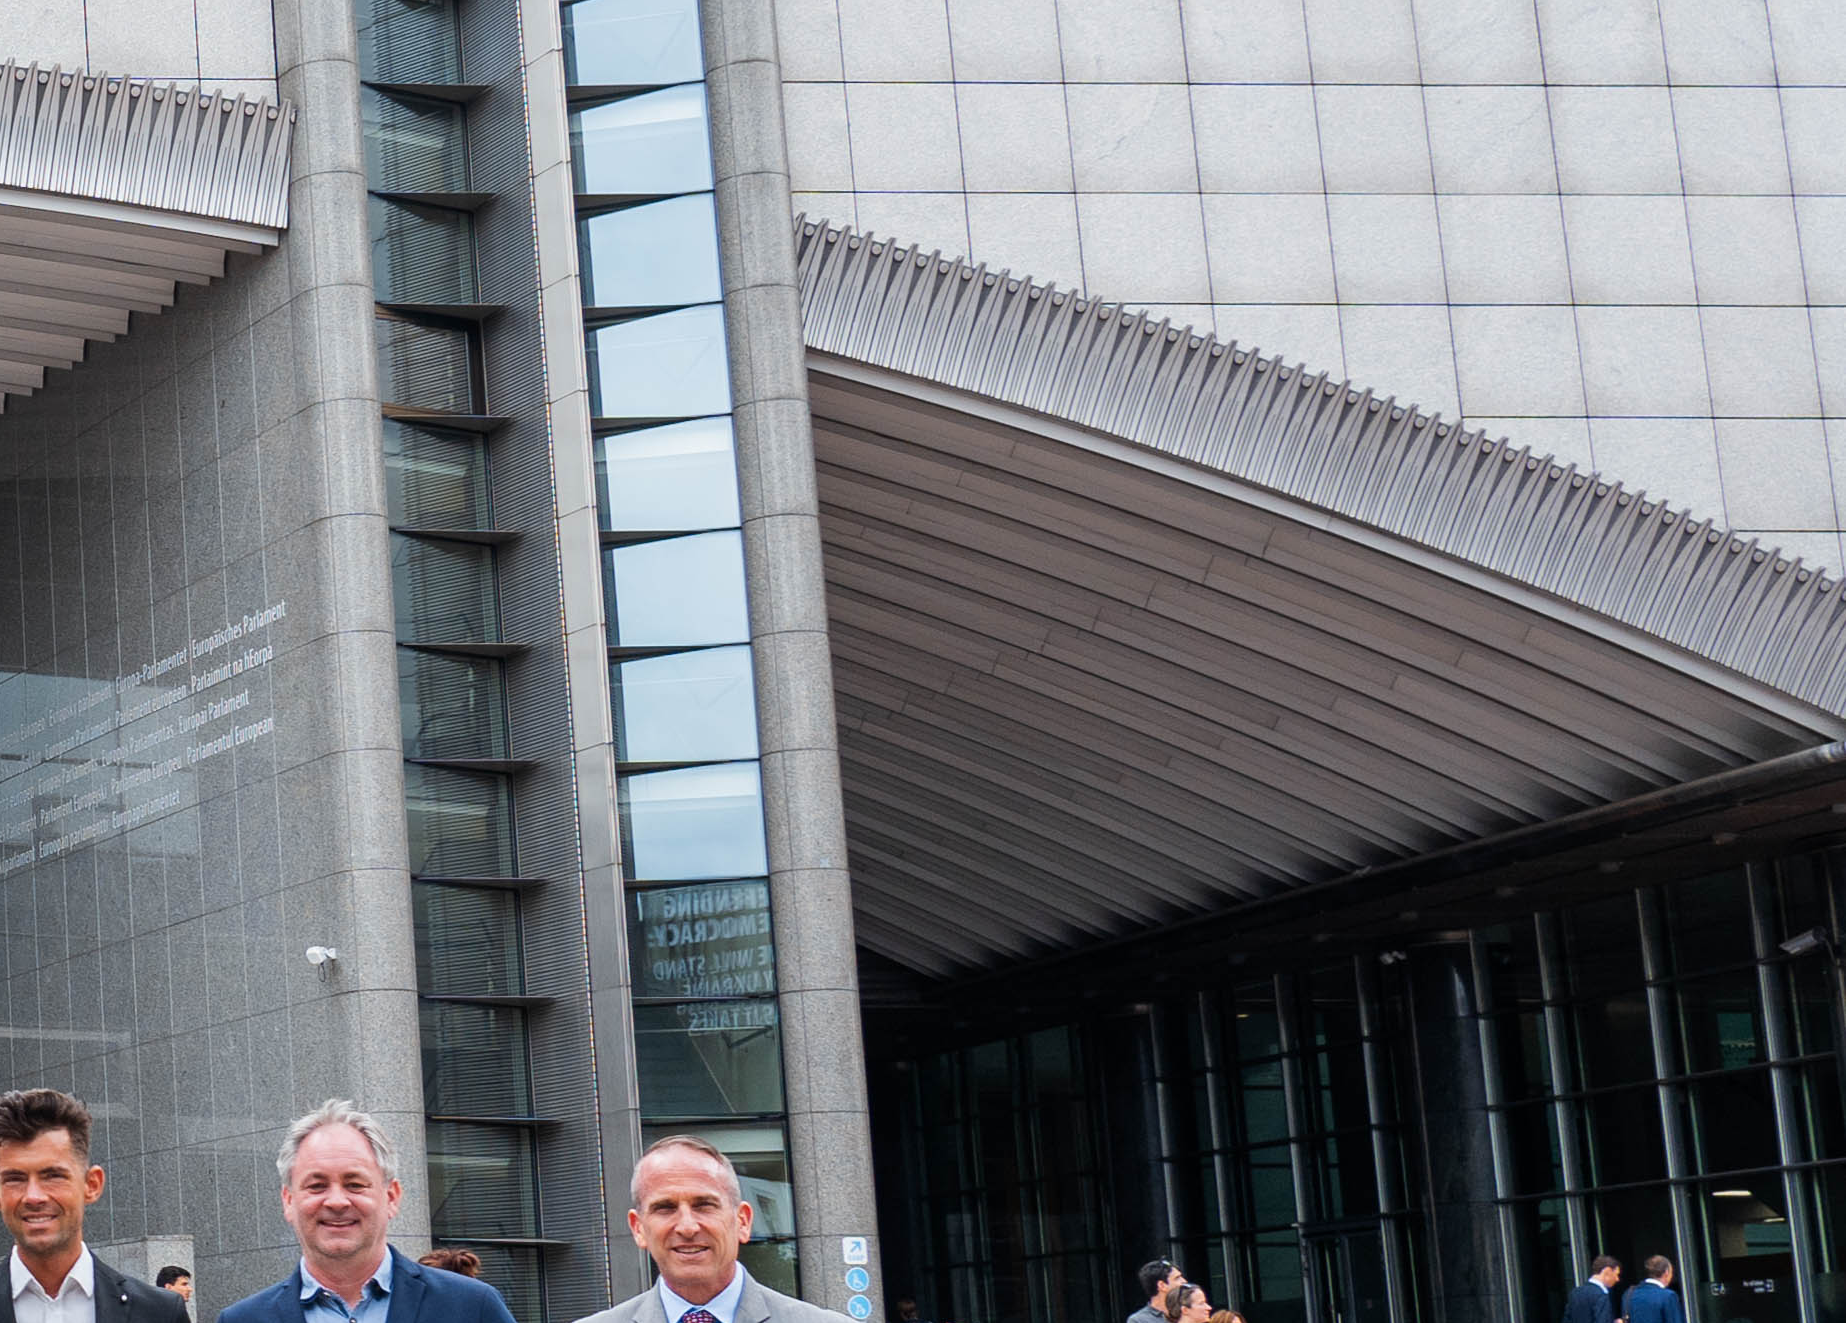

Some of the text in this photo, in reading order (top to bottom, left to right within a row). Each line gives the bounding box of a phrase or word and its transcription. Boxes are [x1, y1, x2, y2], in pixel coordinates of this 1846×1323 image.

[192, 622, 242, 659] Europäisches
[243, 599, 287, 635] Parlament
[191, 659, 232, 694] Parlaimint
[232, 658, 244, 675] na
[244, 644, 274, 671] hEorpa
[209, 688, 250, 720] Parlament
[186, 728, 234, 765] Parlamentul
[235, 717, 274, 746] European
